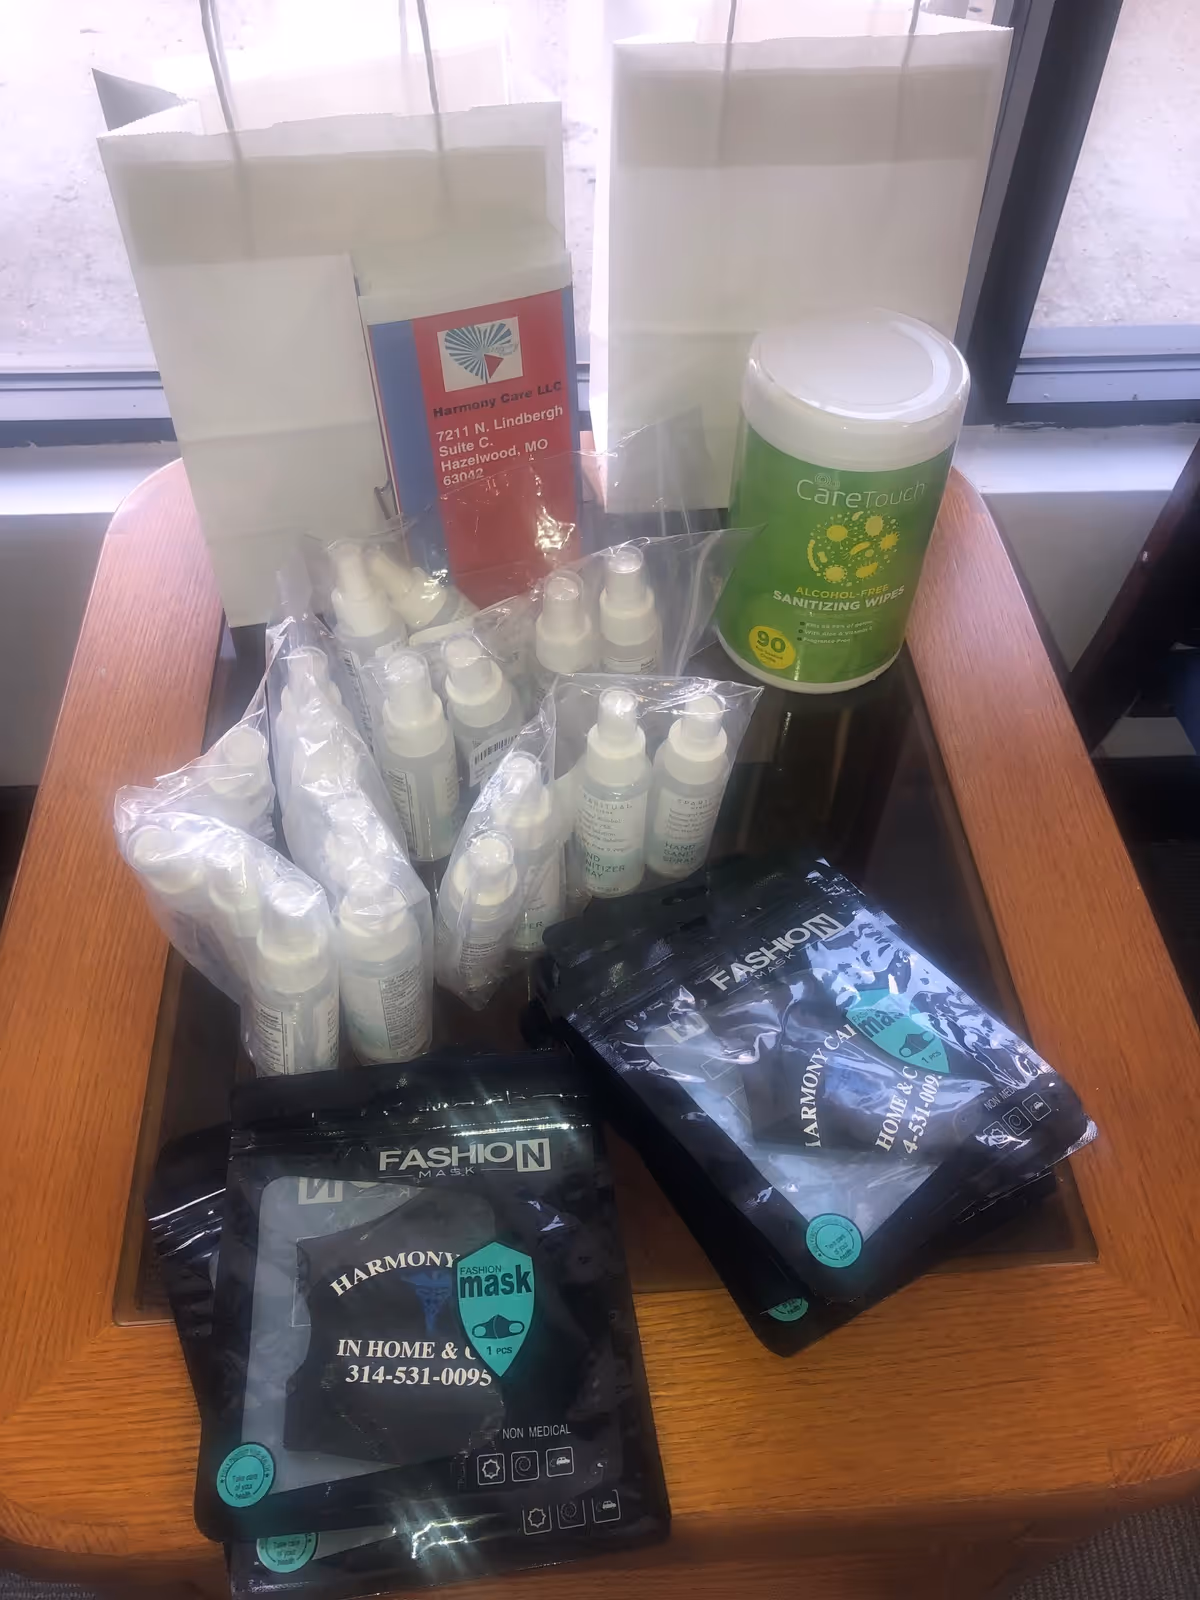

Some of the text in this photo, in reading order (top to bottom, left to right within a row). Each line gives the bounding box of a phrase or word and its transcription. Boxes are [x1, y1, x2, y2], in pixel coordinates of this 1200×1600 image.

[433, 381, 562, 417] Harmony Care LLC
[436, 405, 563, 442] 7211 N. Lindbergh
[439, 437, 494, 457] Suite C.
[441, 438, 548, 472] Hazelwood, MO
[443, 468, 484, 486] 63042
[773, 585, 905, 611] SANITIZING WIPES
[796, 584, 889, 599] ALCOHOL-FREE
[757, 630, 786, 654] 90
[586, 858, 625, 873] NITIZER
[710, 913, 845, 991] FASHION
[755, 952, 796, 979] MASK
[903, 1073, 942, 1154] 4-531-009
[984, 1096, 1000, 1111] NON
[875, 1095, 908, 1151] HOME
[897, 1081, 914, 1095] &
[378, 1138, 551, 1172] FASHION
[418, 1166, 475, 1179] MASK
[329, 1250, 460, 1297] HARMONY
[460, 1265, 502, 1275] FASHION
[460, 1264, 532, 1299] mask
[336, 1339, 363, 1358] IN
[366, 1341, 435, 1359] HOME
[441, 1341, 458, 1360] &
[486, 1346, 493, 1355] 1
[496, 1346, 513, 1355] PCS
[345, 1364, 492, 1387] 314-531-0095
[502, 1424, 572, 1440] NON MEDICAL
